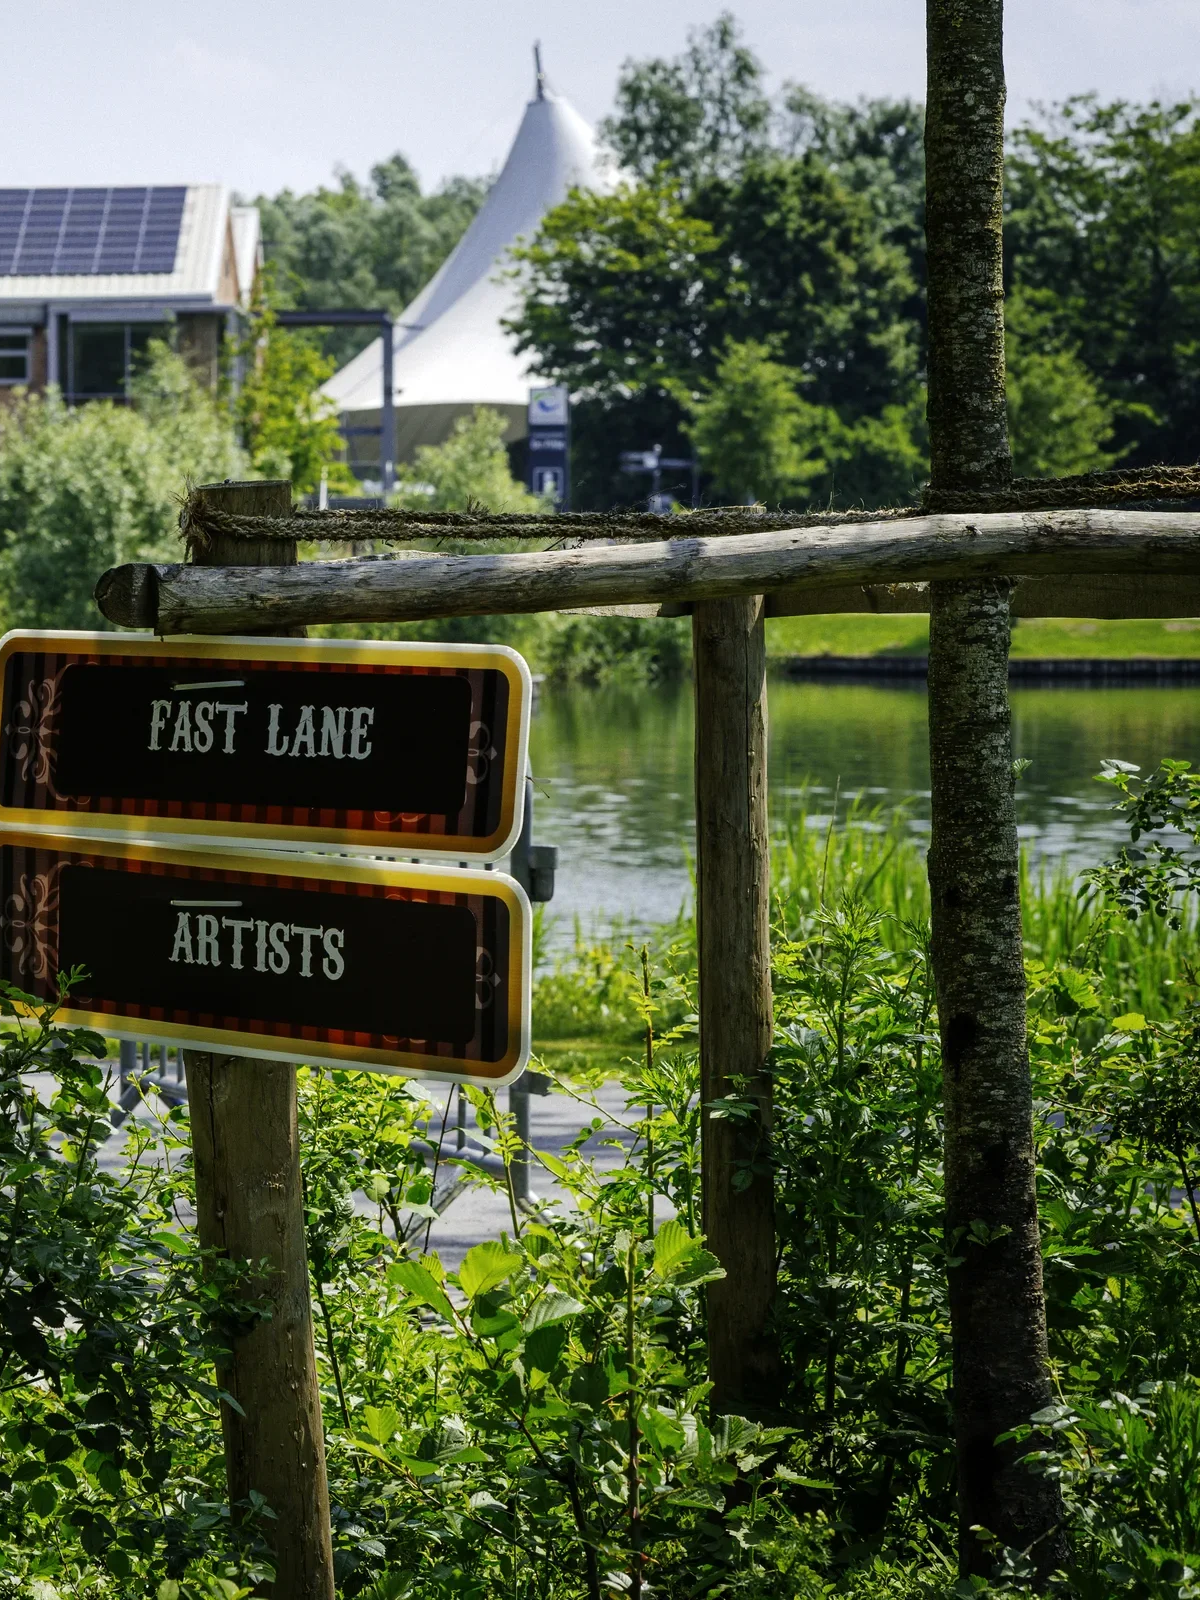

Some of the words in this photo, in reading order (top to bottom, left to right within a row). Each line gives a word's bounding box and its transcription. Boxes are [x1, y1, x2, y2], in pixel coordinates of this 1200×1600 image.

[148, 700, 248, 753] FAST
[265, 704, 374, 759] LANE
[169, 912, 344, 981] ARTISTS
